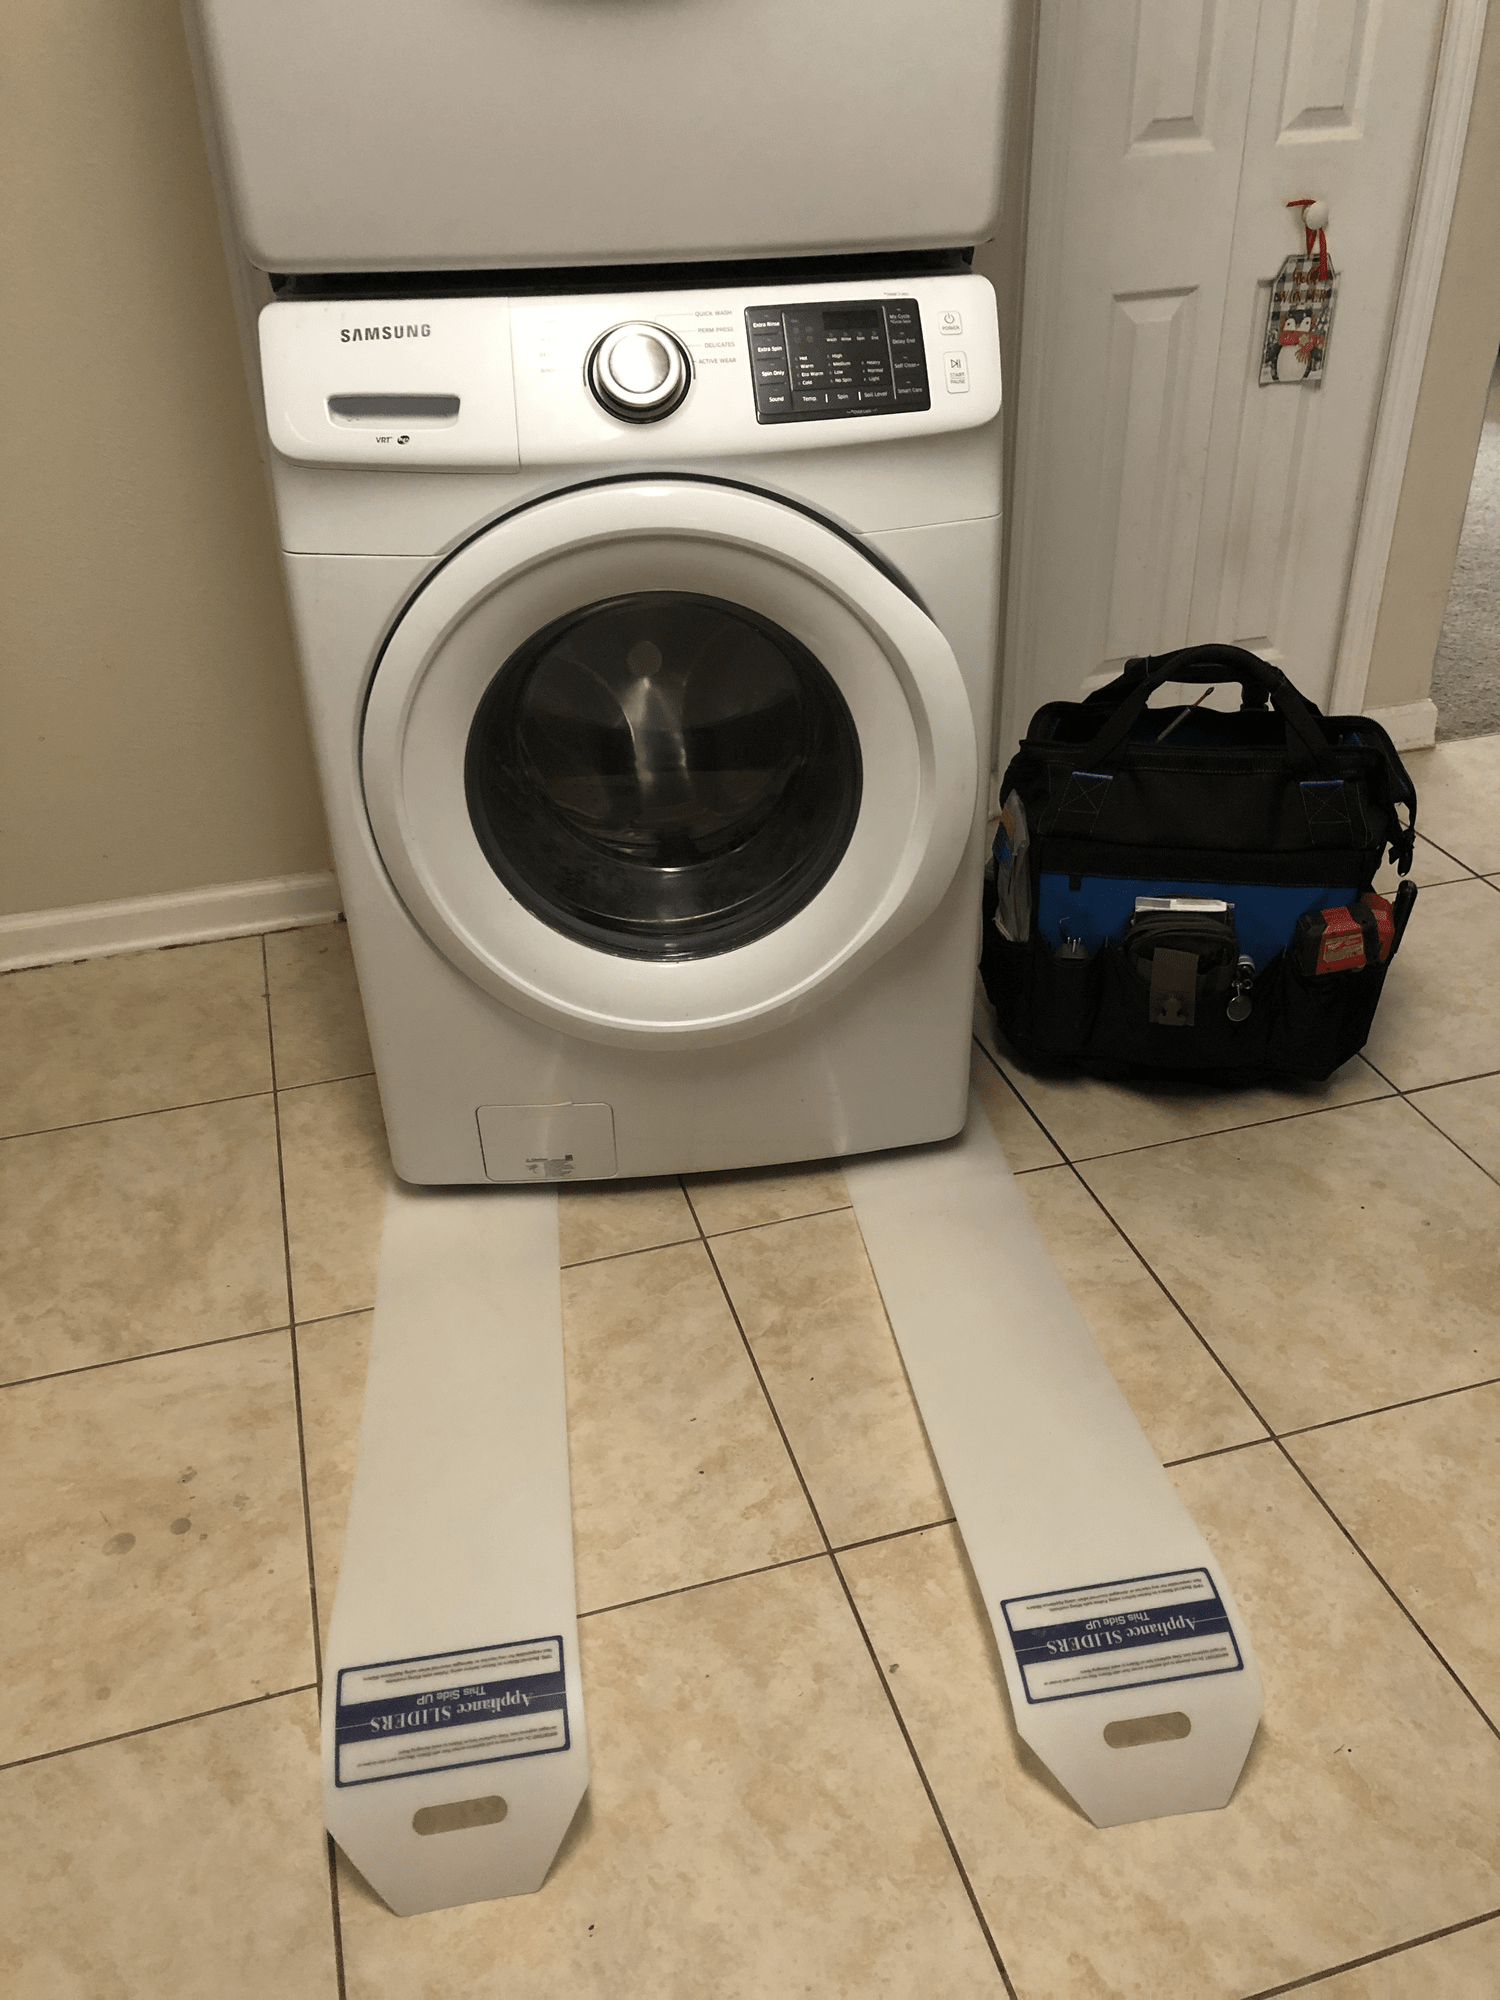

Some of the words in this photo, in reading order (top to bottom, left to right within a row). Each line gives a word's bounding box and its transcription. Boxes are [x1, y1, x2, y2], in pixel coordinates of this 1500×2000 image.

[340, 324, 431, 342] SAMSUNG
[1104, 1615, 1124, 1626] Side
[1127, 1611, 1149, 1622] This
[1086, 1620, 1100, 1630] UP
[1125, 1615, 1196, 1639] Appliance
[1046, 1629, 1123, 1654] SLIDERS
[437, 1689, 460, 1701] Side
[463, 1685, 486, 1697] This
[417, 1693, 433, 1705] UP
[457, 1690, 532, 1715] Appliance
[370, 1705, 451, 1732] SLIDERS
